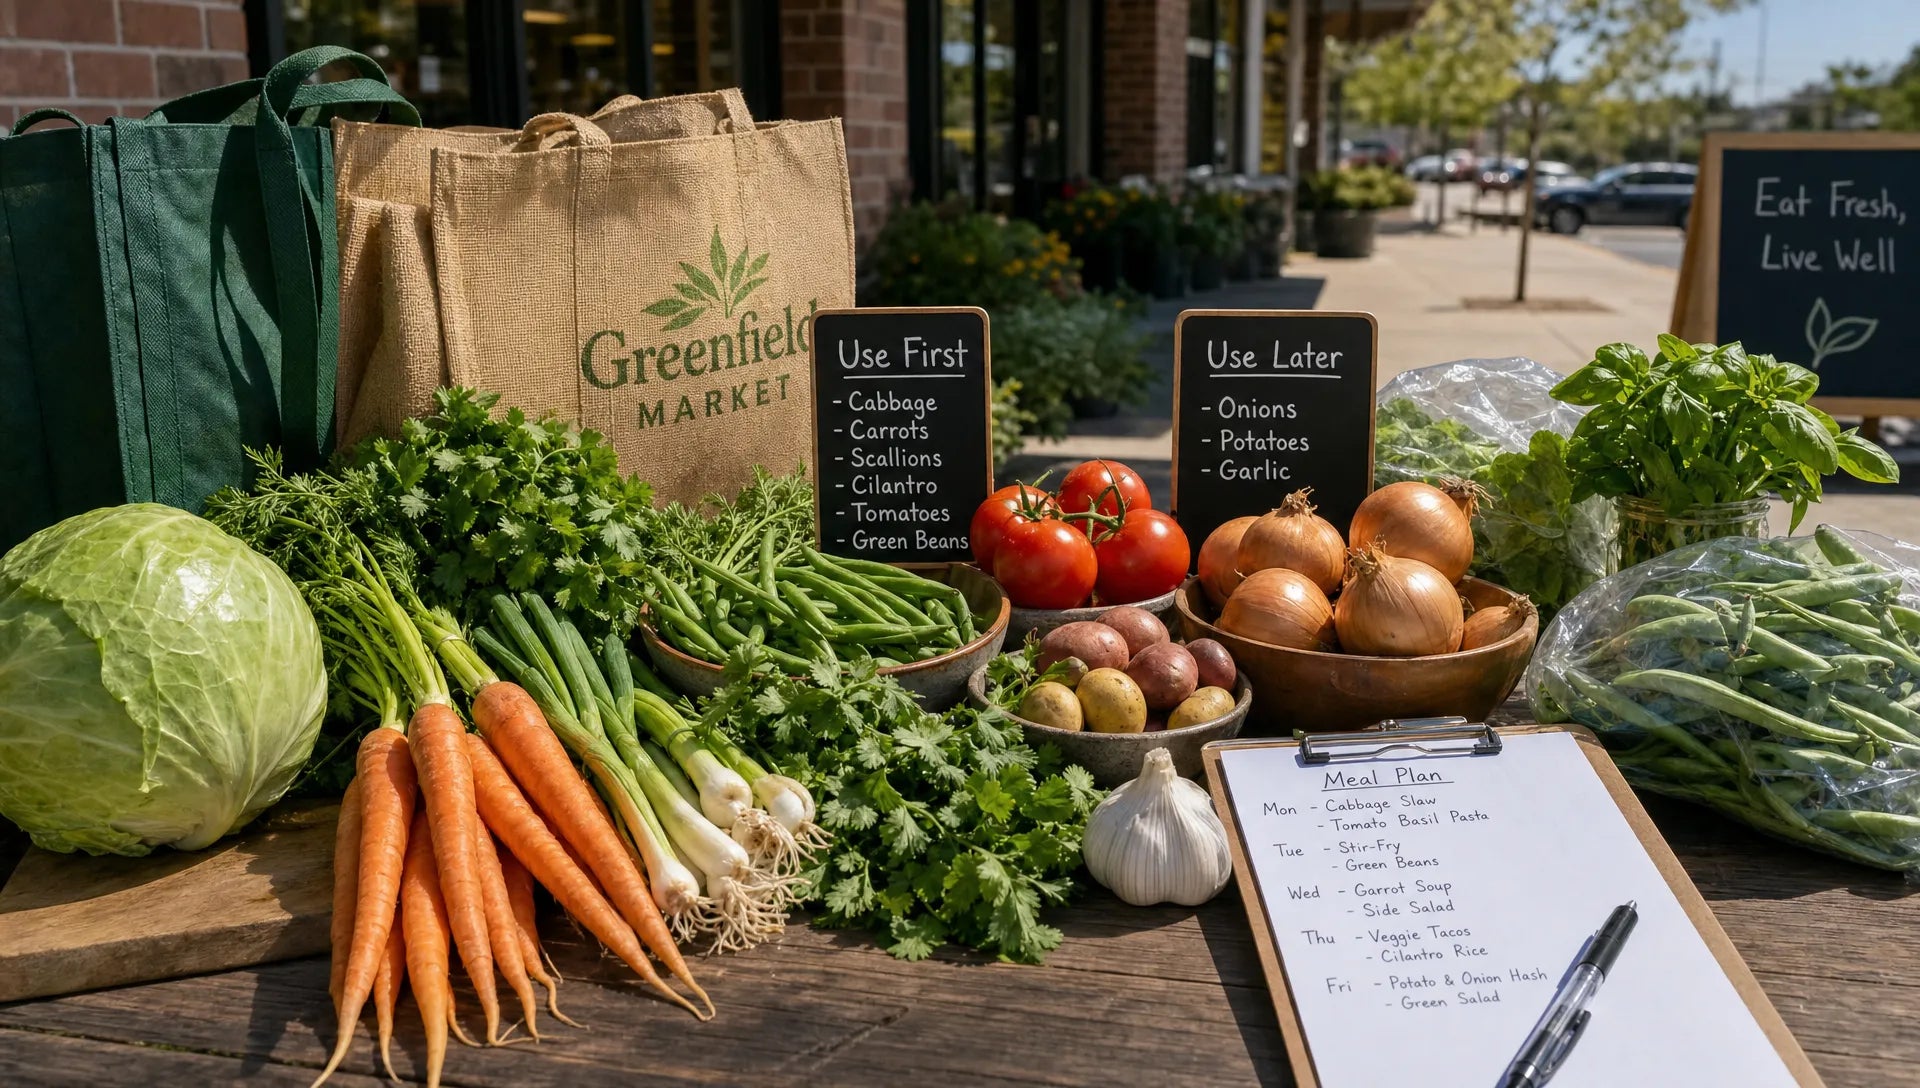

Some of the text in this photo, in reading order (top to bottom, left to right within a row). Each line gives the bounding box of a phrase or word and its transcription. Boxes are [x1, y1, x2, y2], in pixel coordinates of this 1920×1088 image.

[1754, 177, 1907, 225] Eat Fresh,
[1761, 233, 1896, 273] Live Well
[839, 337, 968, 369] Use First
[1208, 340, 1343, 369] Use Later
[638, 374, 790, 429] MARKET
[848, 391, 938, 420] Cabbage
[1218, 396, 1297, 418] Onions
[850, 419, 929, 439] Carrots
[1220, 429, 1310, 452] Potatoes
[851, 447, 942, 468] Scallions
[1219, 459, 1291, 480] Garlic
[852, 475, 937, 494] Cilantro
[851, 502, 950, 522] Tomatoes
[852, 529, 907, 549] Green
[916, 530, 968, 549] Beans
[1323, 767, 1442, 789] Meal Plan
[1263, 802, 1297, 816] Mon
[1326, 799, 1391, 814] Cabbage
[1401, 795, 1436, 807] Slaw
[1330, 817, 1387, 832] Tomato
[1399, 812, 1439, 827] Basil
[1450, 810, 1489, 822] Pasta
[1273, 843, 1304, 857] Tue
[1339, 839, 1401, 855] Stir-Fry
[1346, 859, 1387, 872] Green
[1396, 856, 1439, 868] Beans
[1287, 886, 1320, 899] Wed
[1416, 879, 1452, 895] Soup
[1363, 904, 1400, 917] Side
[1409, 899, 1455, 914] Salad
[1301, 930, 1335, 945] Thu
[1368, 930, 1421, 947] Veggie
[1427, 925, 1471, 939] Tacos
[1381, 949, 1443, 963] Cilantro
[1454, 944, 1488, 957] Rice
[1326, 978, 1352, 994] Fri
[1390, 976, 1436, 990] Potato
[1444, 974, 1454, 985] &
[1461, 971, 1502, 985] Onion
[1510, 967, 1547, 982] Hash
[1401, 996, 1447, 1009] Green
[1458, 991, 1500, 1005] Salad
